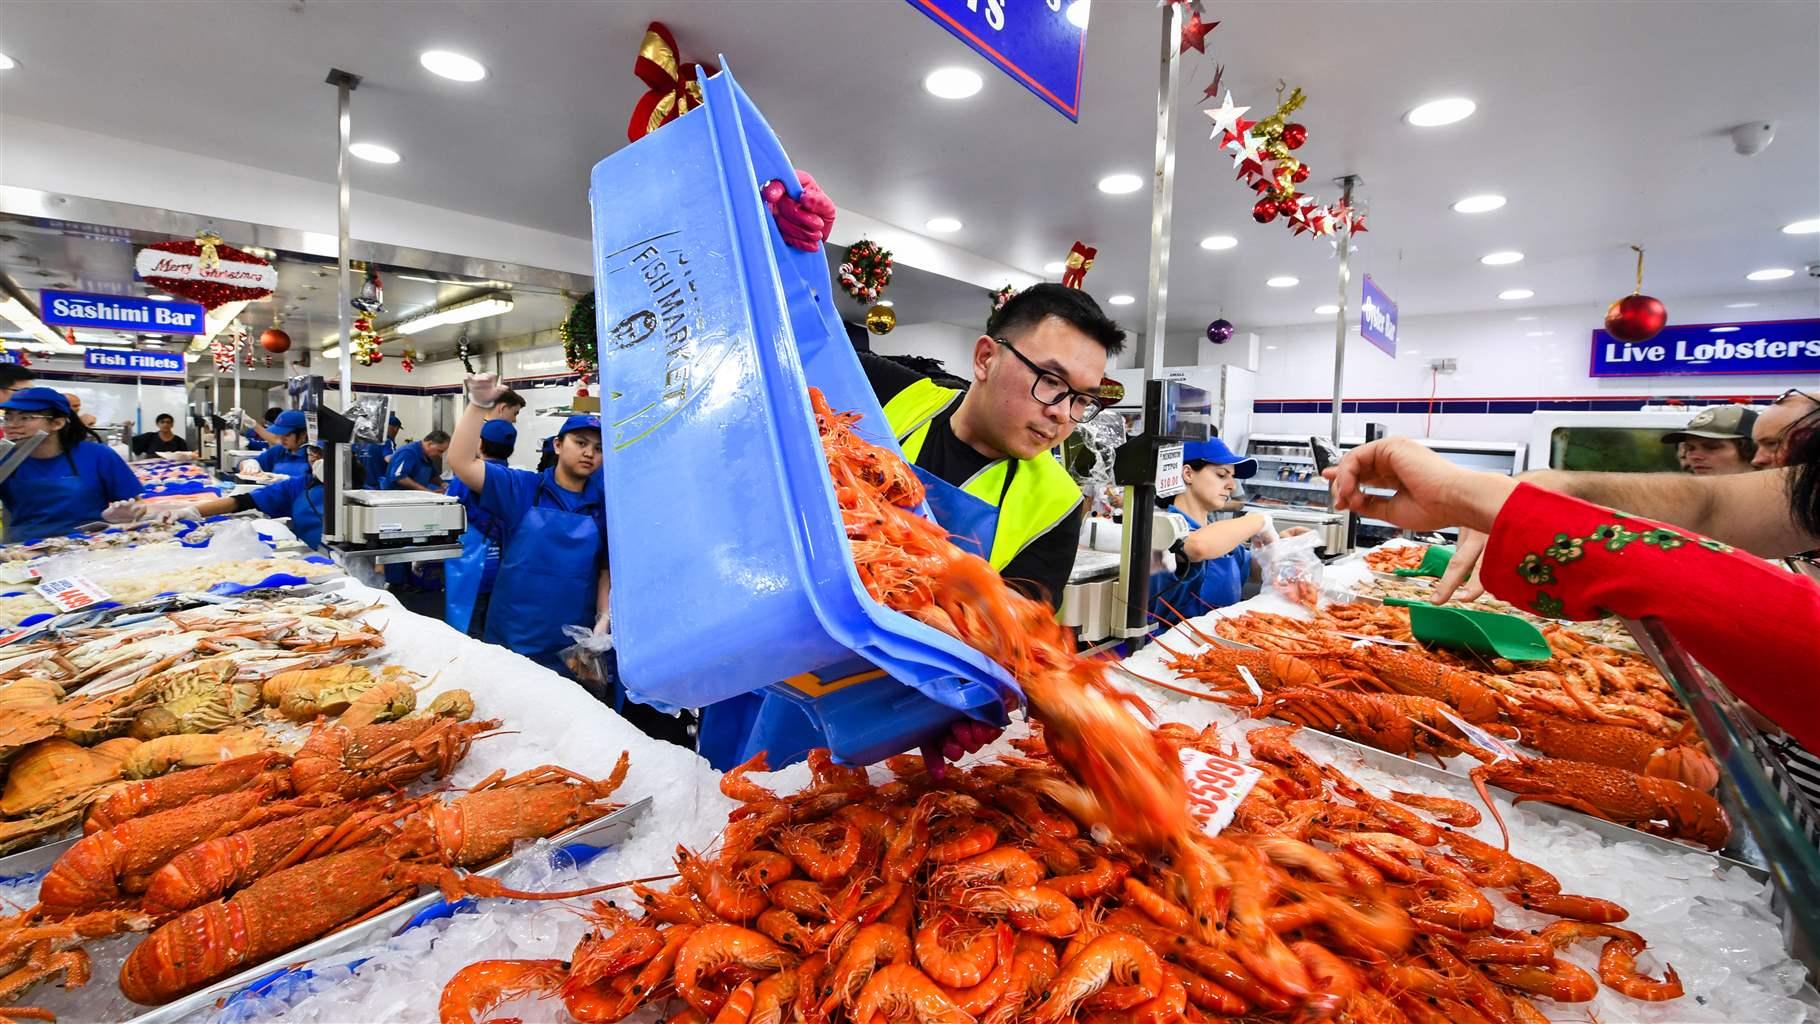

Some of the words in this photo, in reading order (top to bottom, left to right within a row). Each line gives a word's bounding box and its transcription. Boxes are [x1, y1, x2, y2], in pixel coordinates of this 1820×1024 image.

[151, 258, 192, 275] Merry
[52, 298, 149, 324] Sashimi
[155, 307, 197, 327] Bar
[631, 245, 675, 294] FISH
[657, 287, 693, 401] MARKET
[89, 352, 126, 367] Fish
[129, 354, 179, 370] Fillets
[1604, 342, 1666, 363] Live
[1674, 337, 1820, 362] Lobsters
